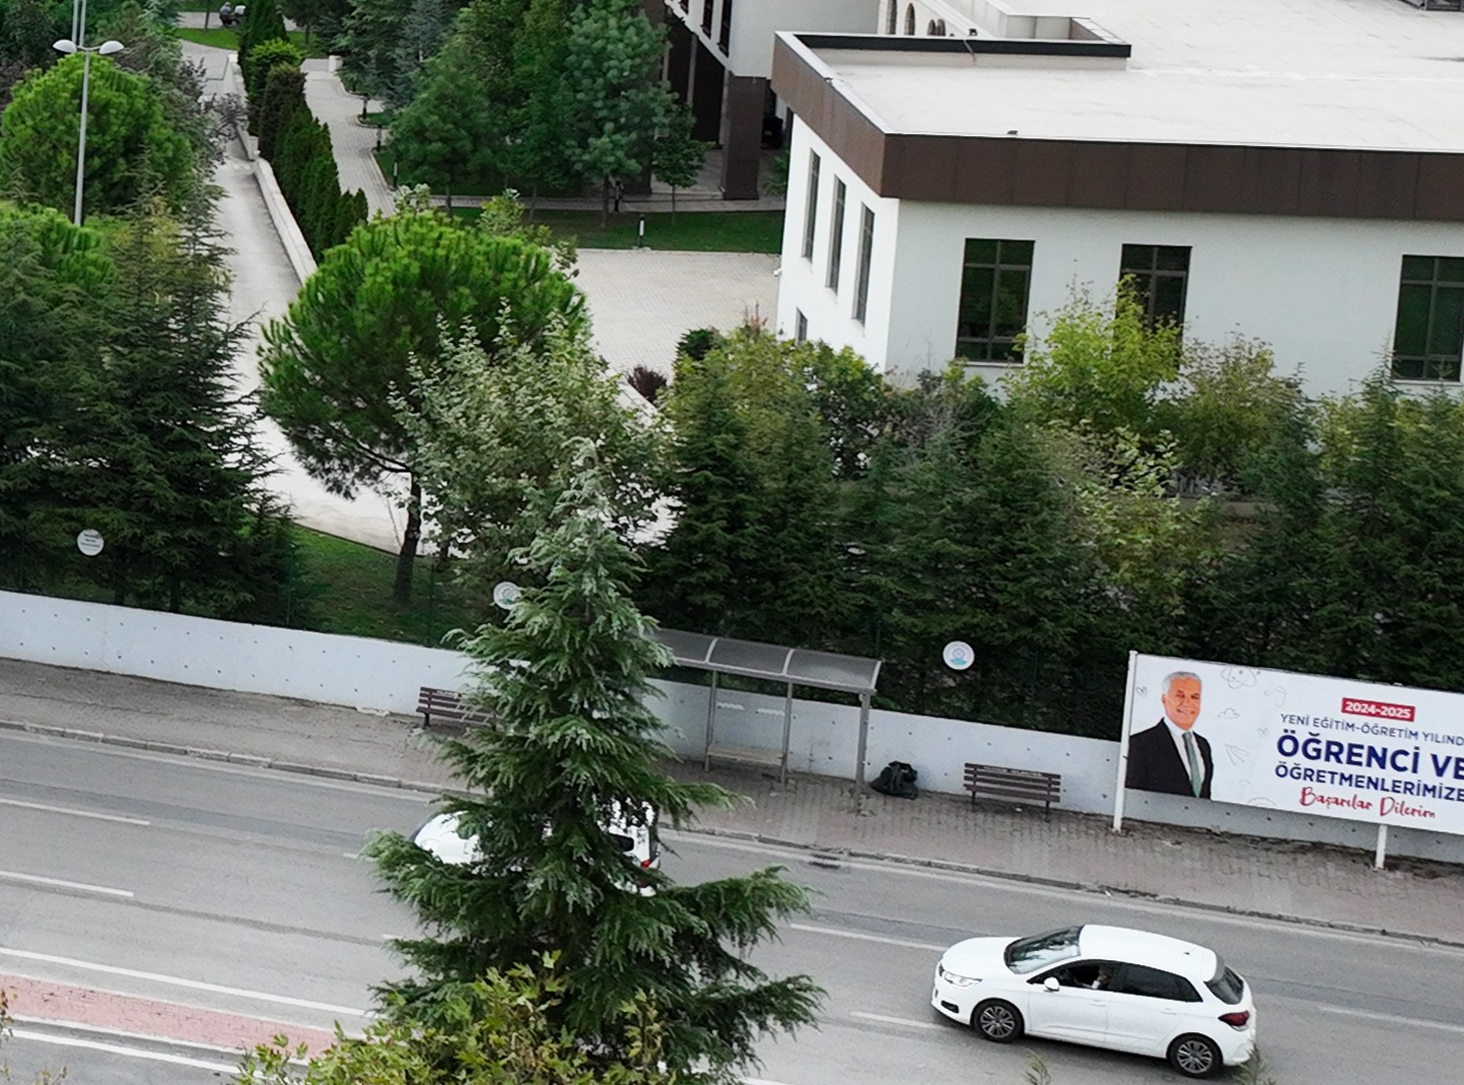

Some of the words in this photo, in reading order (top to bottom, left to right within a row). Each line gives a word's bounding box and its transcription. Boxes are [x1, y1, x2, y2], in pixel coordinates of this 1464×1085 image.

[1344, 700, 1412, 720] 2024-2025
[1280, 713, 1310, 726] YENİ
[1312, 717, 1419, 740] EĞİTİM-ÖĞRETİM
[1276, 728, 1421, 775] ÖĞRENCİ
[1274, 760, 1464, 803] ÖĞRETMENLERİMİZE
[1298, 786, 1373, 811] Başarılar
[1379, 796, 1436, 818] Dilerim
